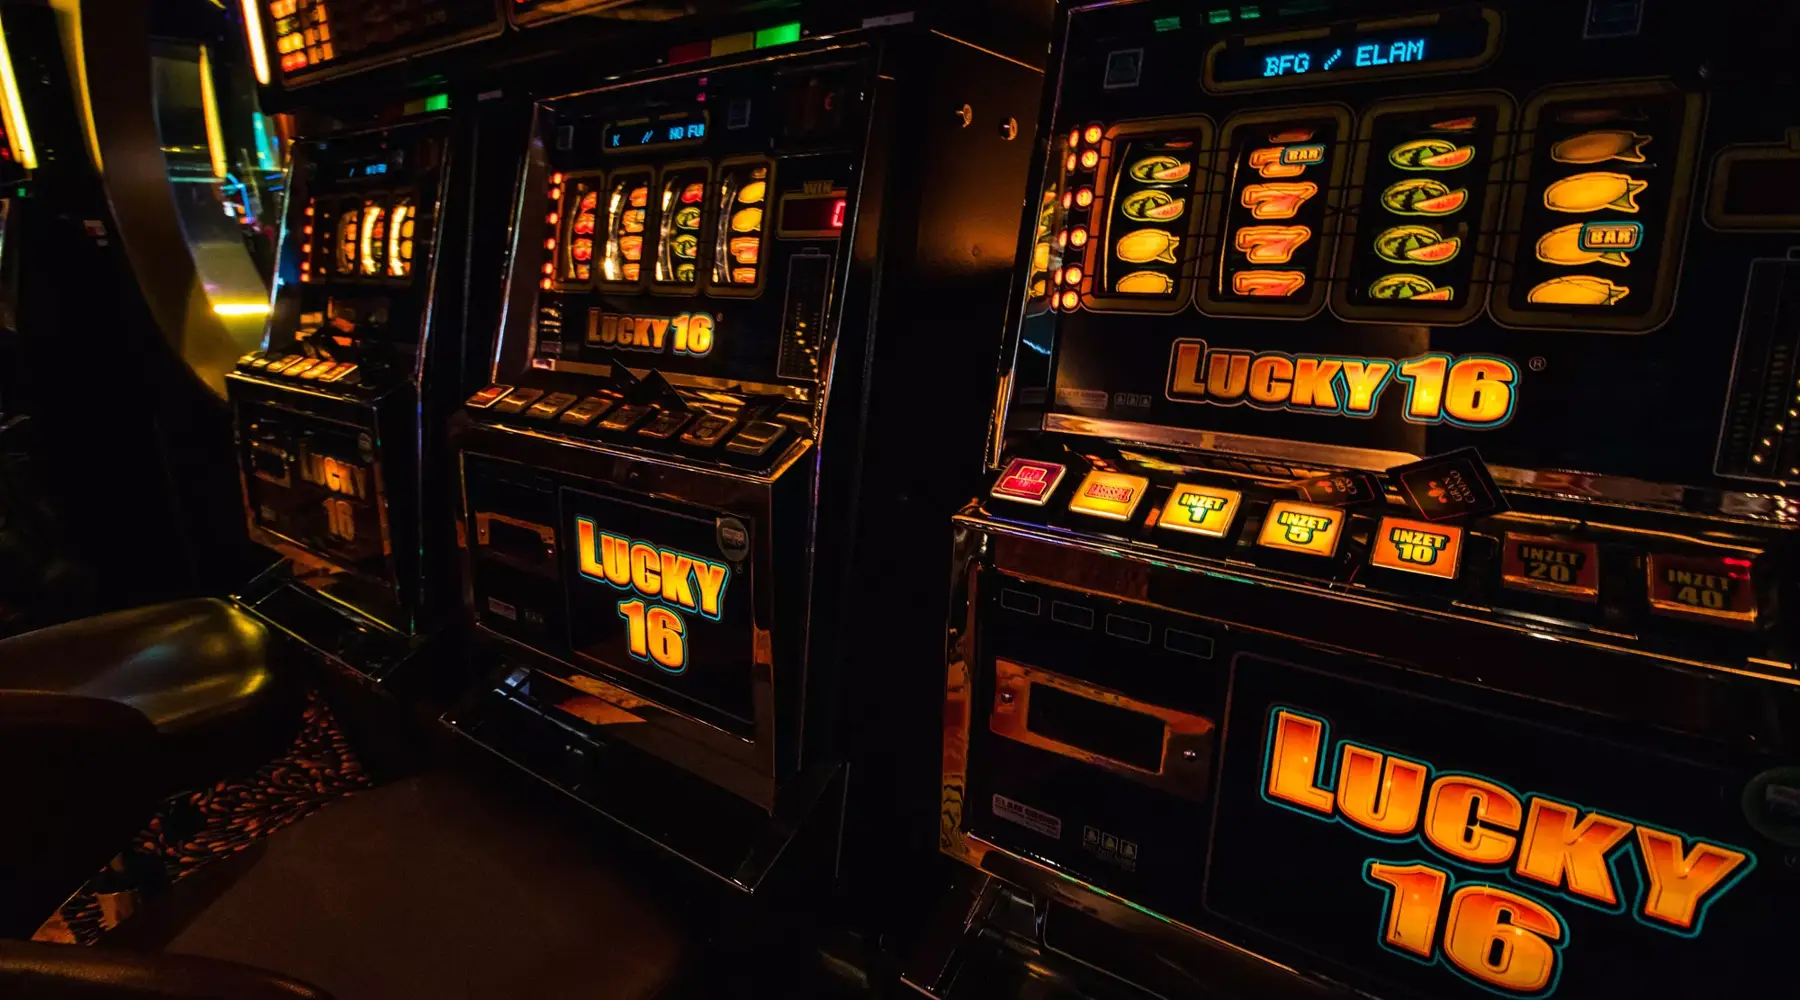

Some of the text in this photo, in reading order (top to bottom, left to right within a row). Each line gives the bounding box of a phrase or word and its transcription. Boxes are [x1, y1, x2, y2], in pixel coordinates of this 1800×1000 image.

[1262, 52, 1311, 77] BFG
[1355, 37, 1427, 68] ELAM
[668, 126, 684, 140] NO
[1591, 230, 1631, 243] BAR
[586, 307, 715, 355] LUCKY 16
[1171, 340, 1395, 412] LUCKY
[1399, 355, 1516, 424] 16
[300, 441, 367, 499] LUCKY
[1180, 493, 1226, 511] INZET
[323, 496, 355, 541] 16
[1189, 505, 1207, 523] 1
[1280, 511, 1332, 531] INZET
[1289, 526, 1312, 543] 5
[1392, 528, 1449, 550] INZET
[1400, 543, 1436, 564] 10
[1521, 545, 1577, 566] INZET
[576, 518, 726, 616] LUCKY
[1528, 562, 1571, 583] 20
[1668, 568, 1732, 592] INZET
[1677, 586, 1724, 609] 40
[618, 599, 685, 669] 16
[1267, 708, 1748, 930] LUCKY
[1369, 861, 1562, 994] 16
